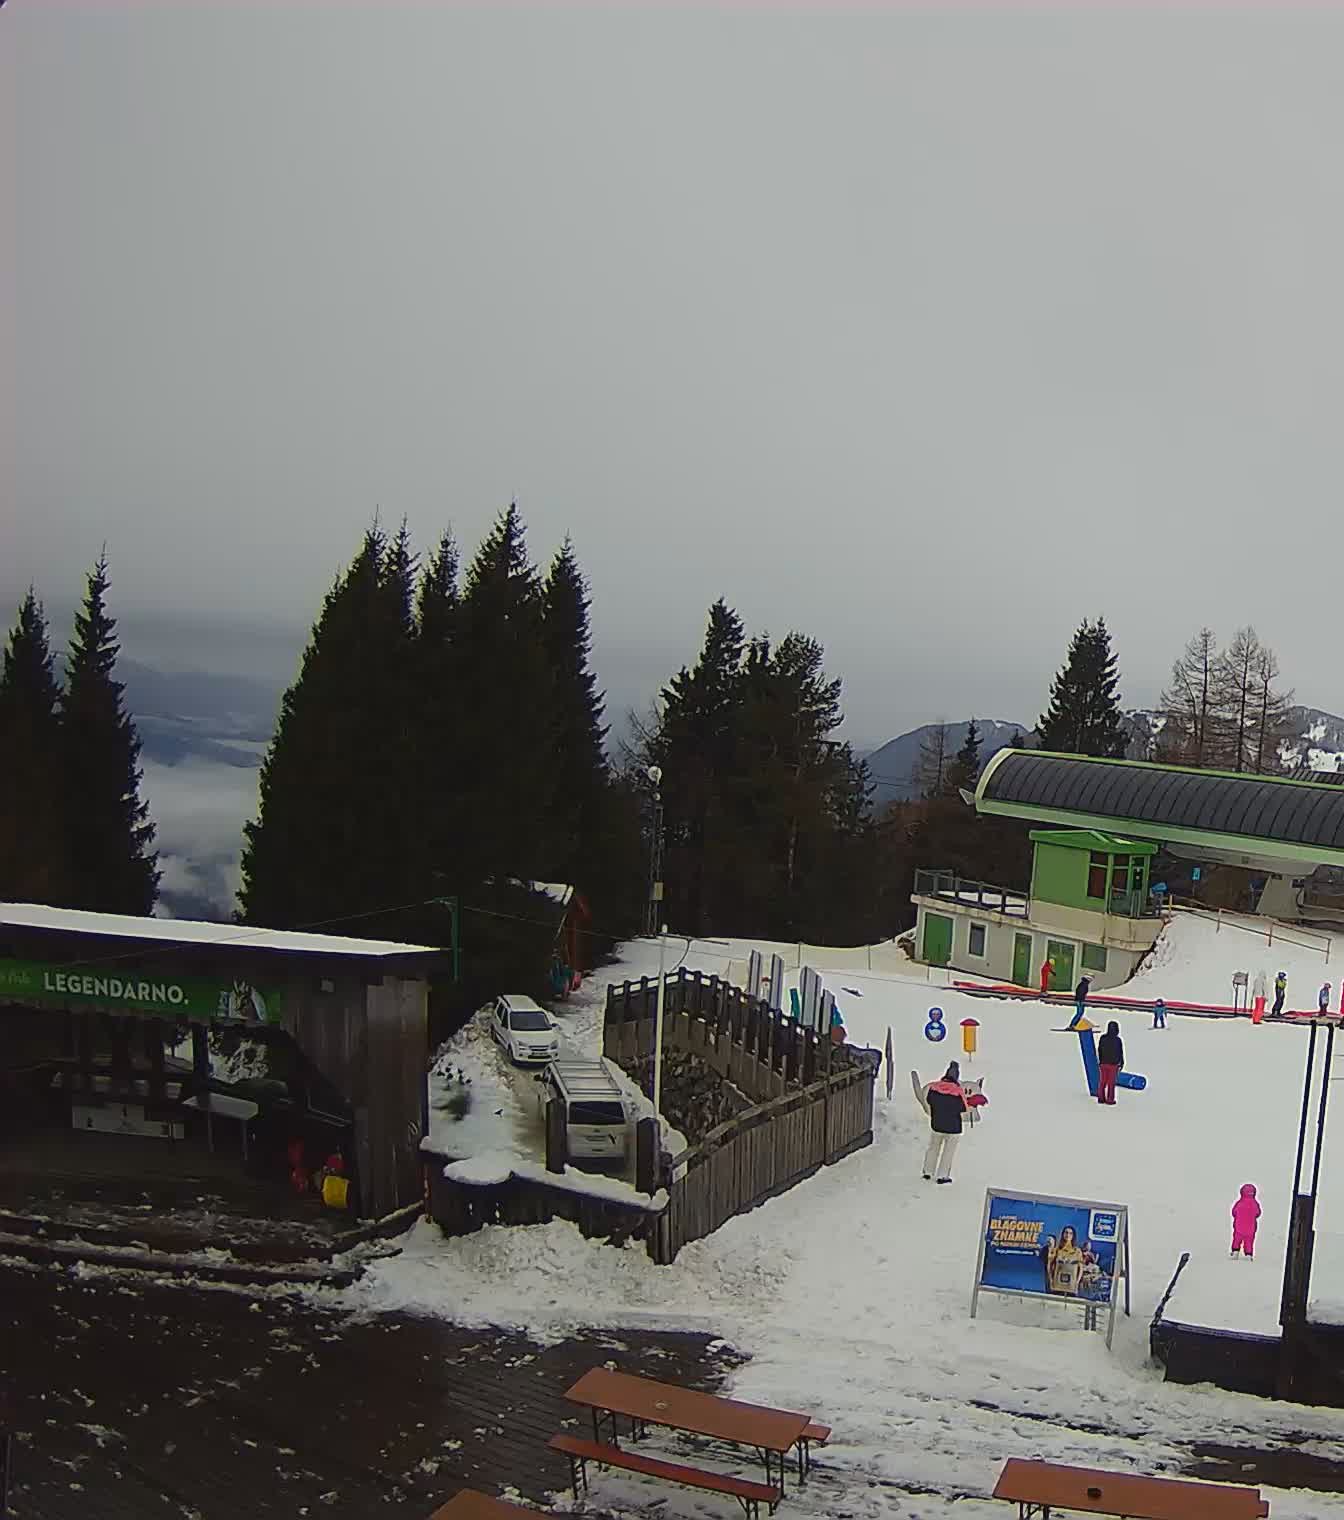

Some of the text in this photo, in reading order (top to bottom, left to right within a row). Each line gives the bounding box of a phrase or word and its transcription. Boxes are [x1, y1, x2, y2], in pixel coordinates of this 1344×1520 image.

[43, 971, 189, 1004] LEGENDARNO.
[990, 1218, 1044, 1232] BLAGOVNE
[993, 1230, 1039, 1243] ZNAMKE
